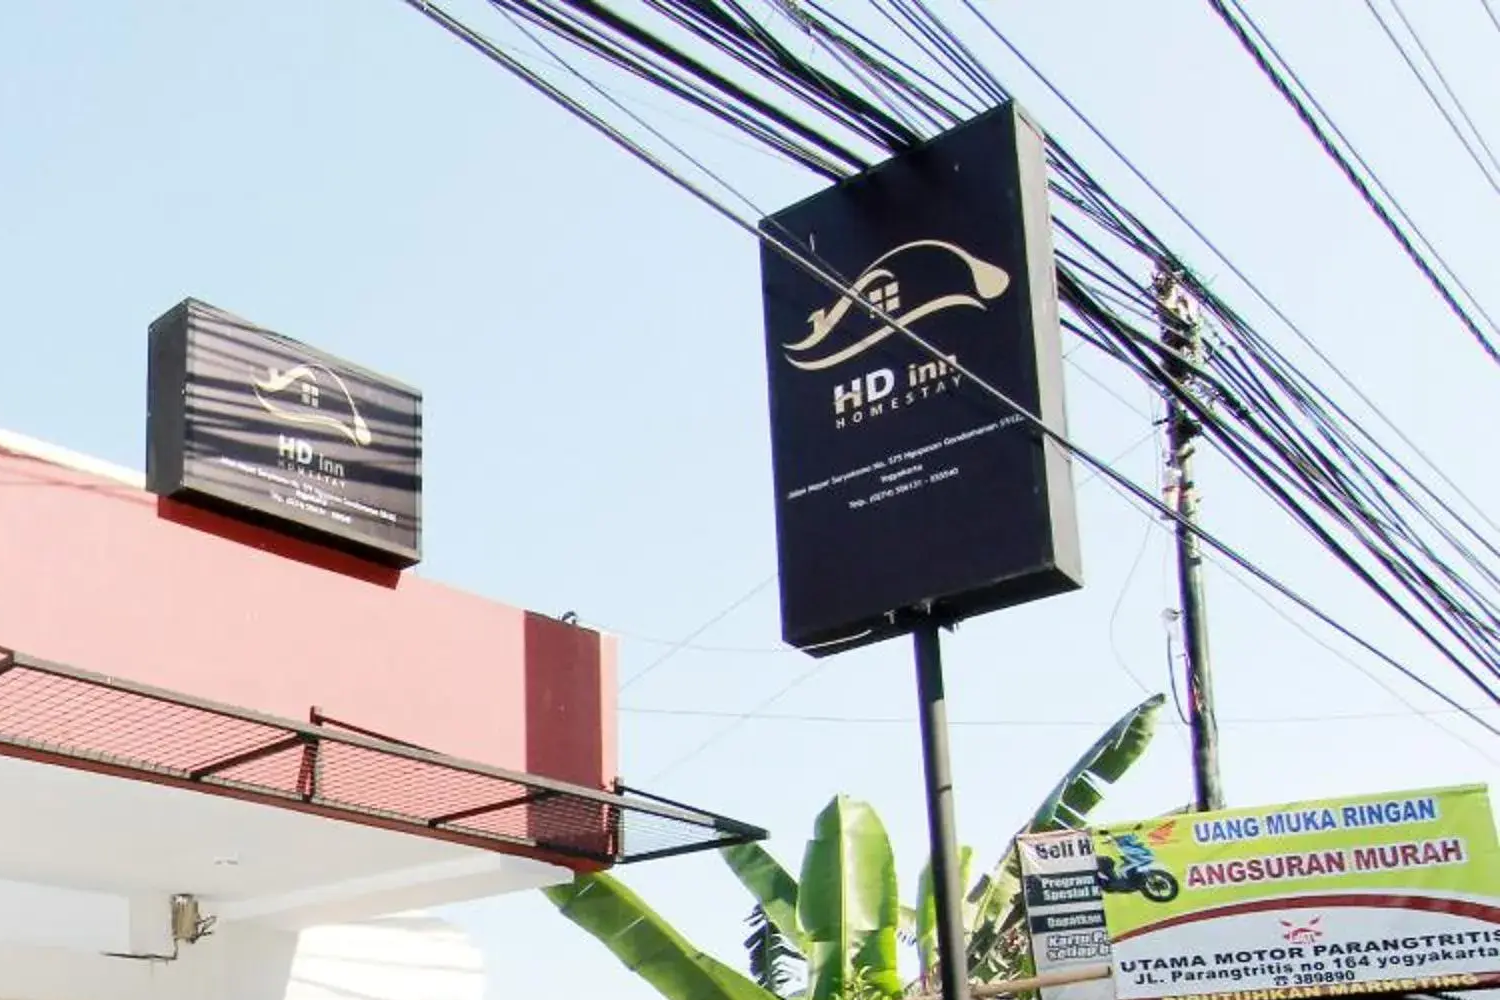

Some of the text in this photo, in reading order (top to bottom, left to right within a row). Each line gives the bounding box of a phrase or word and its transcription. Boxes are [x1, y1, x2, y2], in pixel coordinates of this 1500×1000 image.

[834, 354, 957, 414] HD inn
[835, 374, 961, 429] HOMESTAY
[279, 433, 312, 465] HD
[1194, 798, 1436, 843] UANG MUKA RINGAN
[1187, 839, 1463, 887] ANGSURAN MURAH
[1120, 955, 1206, 973] UTAMA
[1215, 947, 1305, 965] MOTOR
[1135, 946, 1499, 985] JL. Parangtritis no 164 yogyakarta
[1293, 970, 1355, 985] 389890
[1329, 973, 1479, 997] MARKETING
